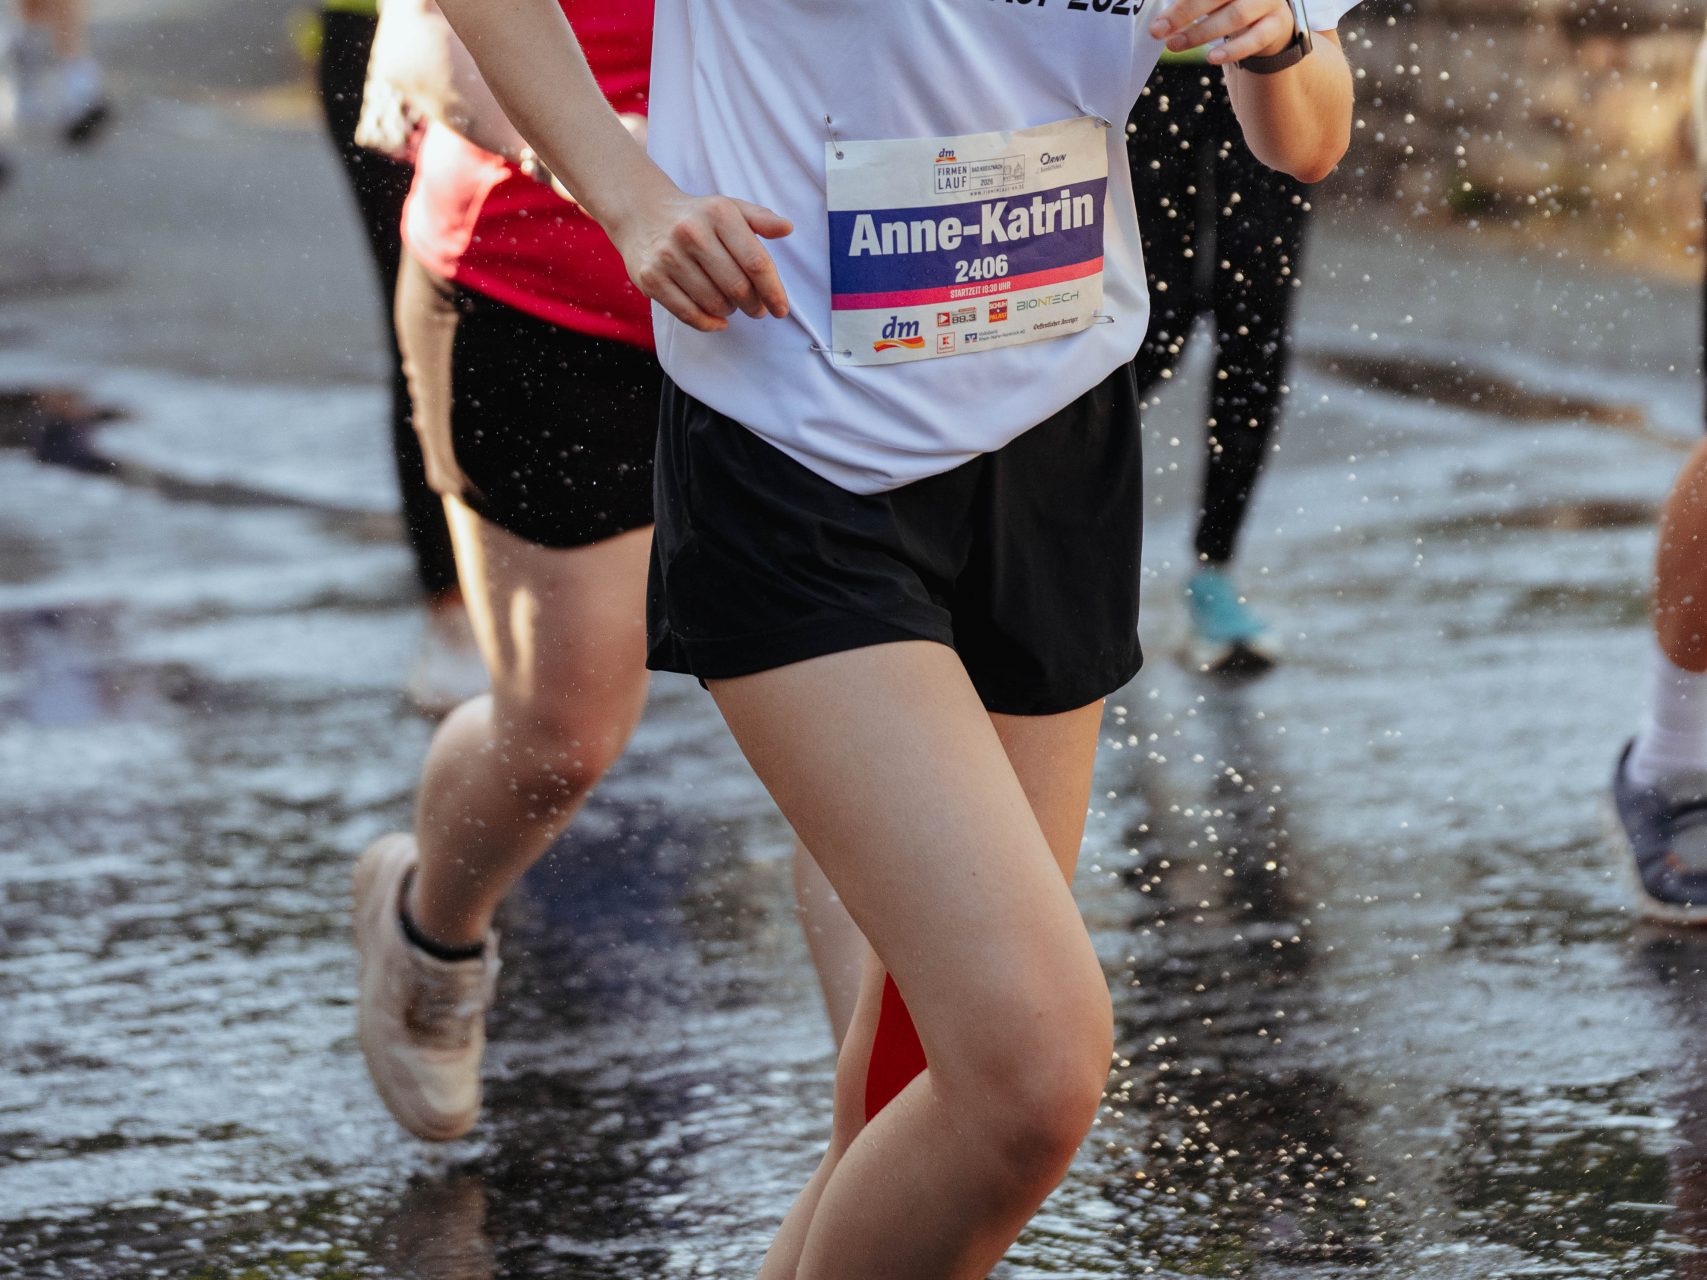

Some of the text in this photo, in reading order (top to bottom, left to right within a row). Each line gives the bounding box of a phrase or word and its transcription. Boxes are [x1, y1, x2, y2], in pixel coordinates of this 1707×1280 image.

[938, 148, 955, 158] dm
[937, 166, 967, 177] FIRMEN
[938, 176, 967, 190] LAUF
[848, 189, 1094, 257] Anne-Katrin
[954, 254, 1009, 283] 2406
[950, 285, 981, 299] STARTZEIT
[998, 281, 1012, 291] UHR
[882, 315, 920, 340] dm
